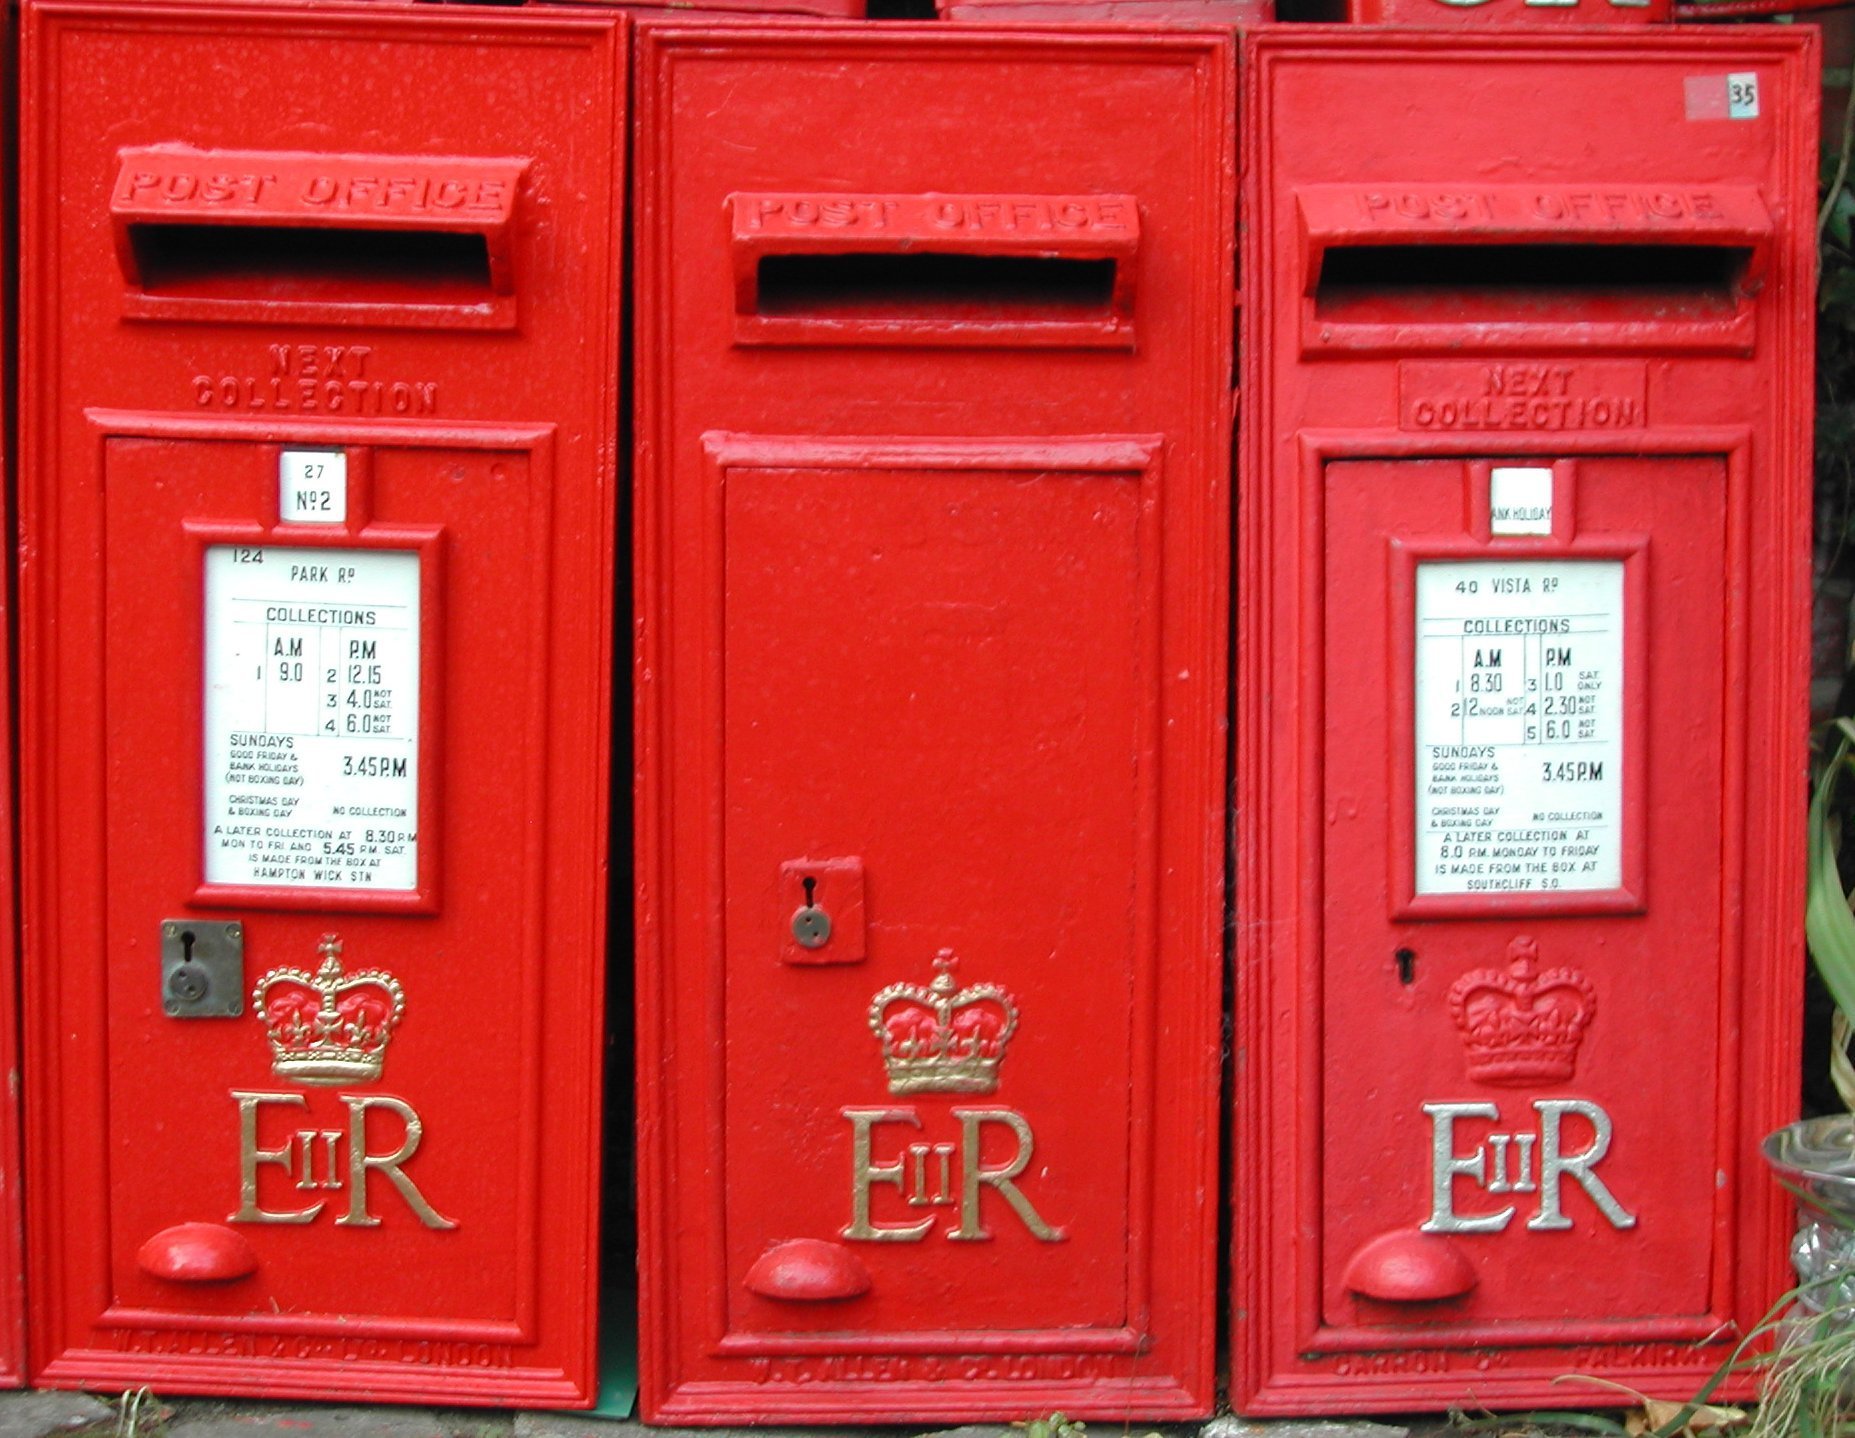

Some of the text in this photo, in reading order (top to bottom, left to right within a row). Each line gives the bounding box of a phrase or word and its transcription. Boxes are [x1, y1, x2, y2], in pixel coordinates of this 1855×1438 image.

[1732, 84, 1754, 106] 35
[120, 171, 506, 211] POST OFFICE
[1358, 190, 1725, 223] POST OFFICE
[746, 199, 1127, 232] POST OFFICE
[268, 343, 373, 378] NEXT
[1485, 367, 1574, 397] NEXT
[191, 375, 440, 413] COLLECTION
[1412, 398, 1637, 429] COLLECTION
[304, 465, 324, 479] 27
[1513, 506, 1552, 520] HOLIDAY
[233, 549, 264, 564] 124
[291, 566, 328, 582] PARK
[1455, 580, 1478, 594] 40
[1492, 578, 1531, 593] VISTA
[266, 607, 376, 625] COLLECTIONS
[1463, 619, 1571, 634] COLLECTIONS
[256, 662, 381, 685] 1 9.0 2 12.15
[1455, 671, 1599, 693] 1 8.30 3 1.0 SAT
[1577, 681, 1602, 690] ONLY
[327, 689, 392, 709] 3 4.0 NOT
[1506, 695, 1596, 705] NOT NOT
[1451, 696, 1595, 717] 2 12 NOON SAT 4 2.30 SAT
[325, 714, 392, 733] 4 6.0 NOT
[1527, 719, 1596, 740] 5 6.0 NOT
[1578, 729, 1595, 738] SAT
[230, 734, 294, 749] SUNDAYS
[230, 750, 298, 761] GOOD FRIDAY &
[1432, 746, 1496, 758] SUNDAYS
[230, 762, 299, 773] BANK HOLIDAYS
[1432, 762, 1498, 771] GOOD FRIDAY &
[225, 773, 304, 787] (NOT BOXING DAY)
[1432, 773, 1499, 783] BANK HOLIDAYS
[1428, 784, 1504, 795] (NOT BOXING DAY)
[229, 794, 300, 806] CHRISTMAS DAY
[238, 807, 271, 817] BOXING
[273, 808, 293, 818] DAY
[332, 806, 407, 817] NO COLLECTION
[1432, 806, 1500, 816] CHRISTMAS DAY
[1532, 812, 1603, 822] NO COLLECTION
[1440, 818, 1473, 828] BOXING
[1475, 818, 1493, 828] DAY
[214, 825, 223, 834] A
[226, 826, 261, 836] LATER
[266, 827, 333, 840] COLLECTION
[339, 831, 352, 840] AT
[365, 829, 395, 843] 8.30
[1443, 830, 1590, 843] A LATER COLLECTION AT
[221, 838, 245, 849] MON
[250, 840, 263, 850] TO
[290, 842, 312, 851] AND
[323, 842, 355, 856] 5.45
[1440, 845, 1462, 859] 8.0
[1492, 846, 1539, 857] MONDAY
[1543, 846, 1556, 856] TO
[1561, 845, 1600, 857] FRIDAY
[248, 853, 381, 867] IS MADE FROM THE BOX AT
[253, 867, 372, 882] HAMPTON WICK STN
[1435, 861, 1598, 874] IS MADE FROM THE BOX AT
[1467, 878, 1533, 890] SOUTHCLIFF
